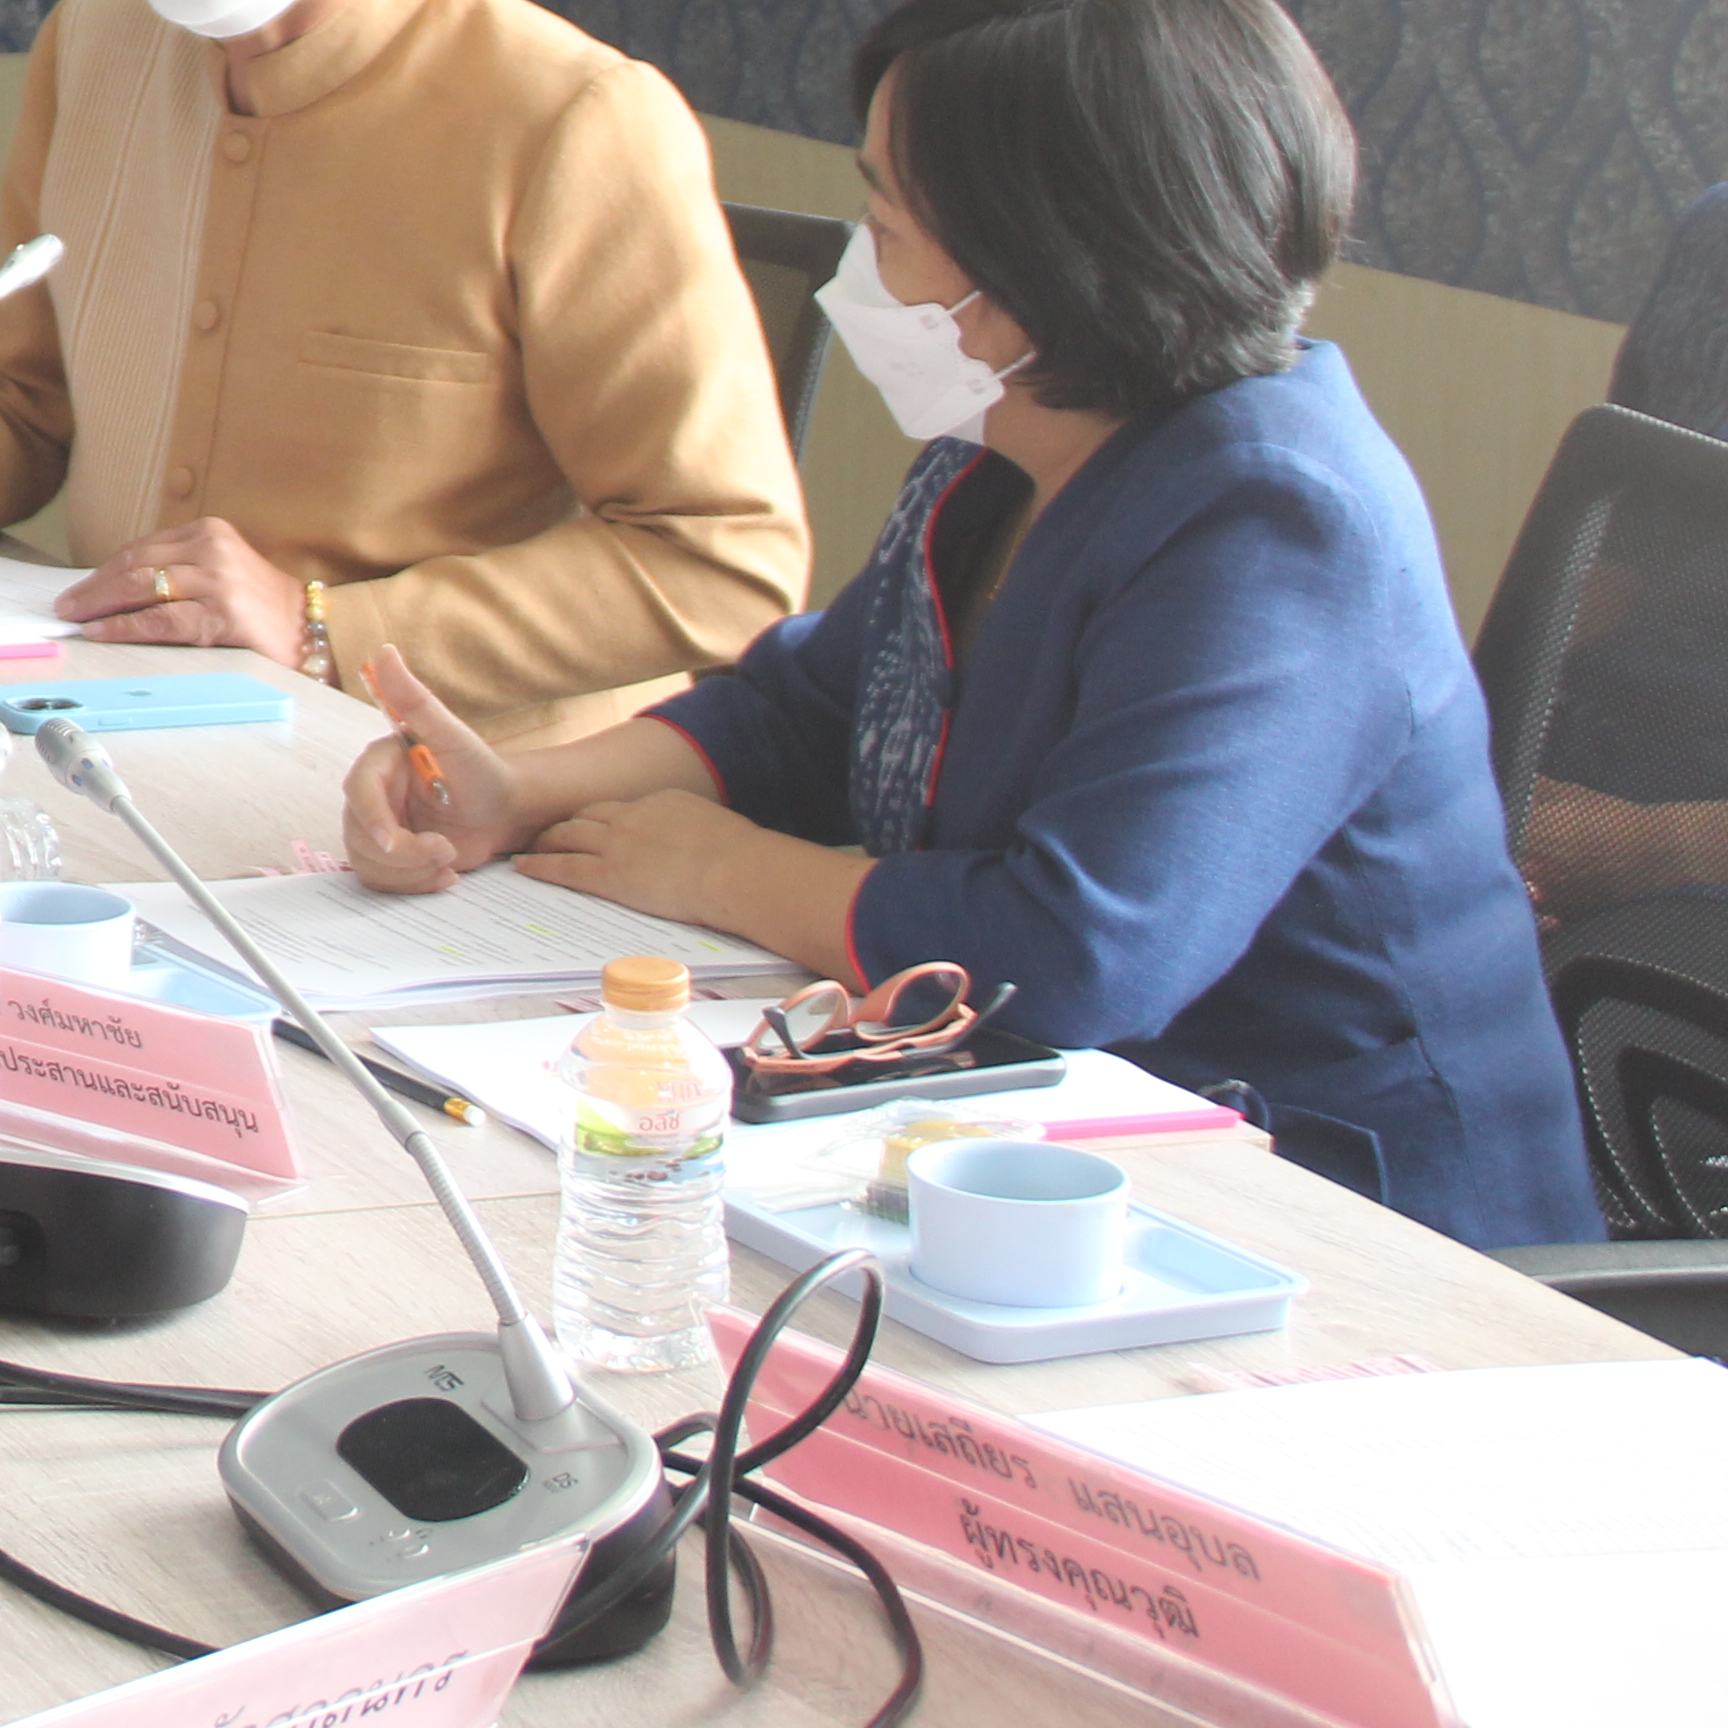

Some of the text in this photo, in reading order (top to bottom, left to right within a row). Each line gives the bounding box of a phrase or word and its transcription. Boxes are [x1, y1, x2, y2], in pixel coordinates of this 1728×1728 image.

[7, 998, 143, 1049] วงศ์มหาชัย
[959, 1497, 1200, 1641] ผู้ทรงคุณวุฒิ
[1068, 1477, 1262, 1582] แสนอุบล
